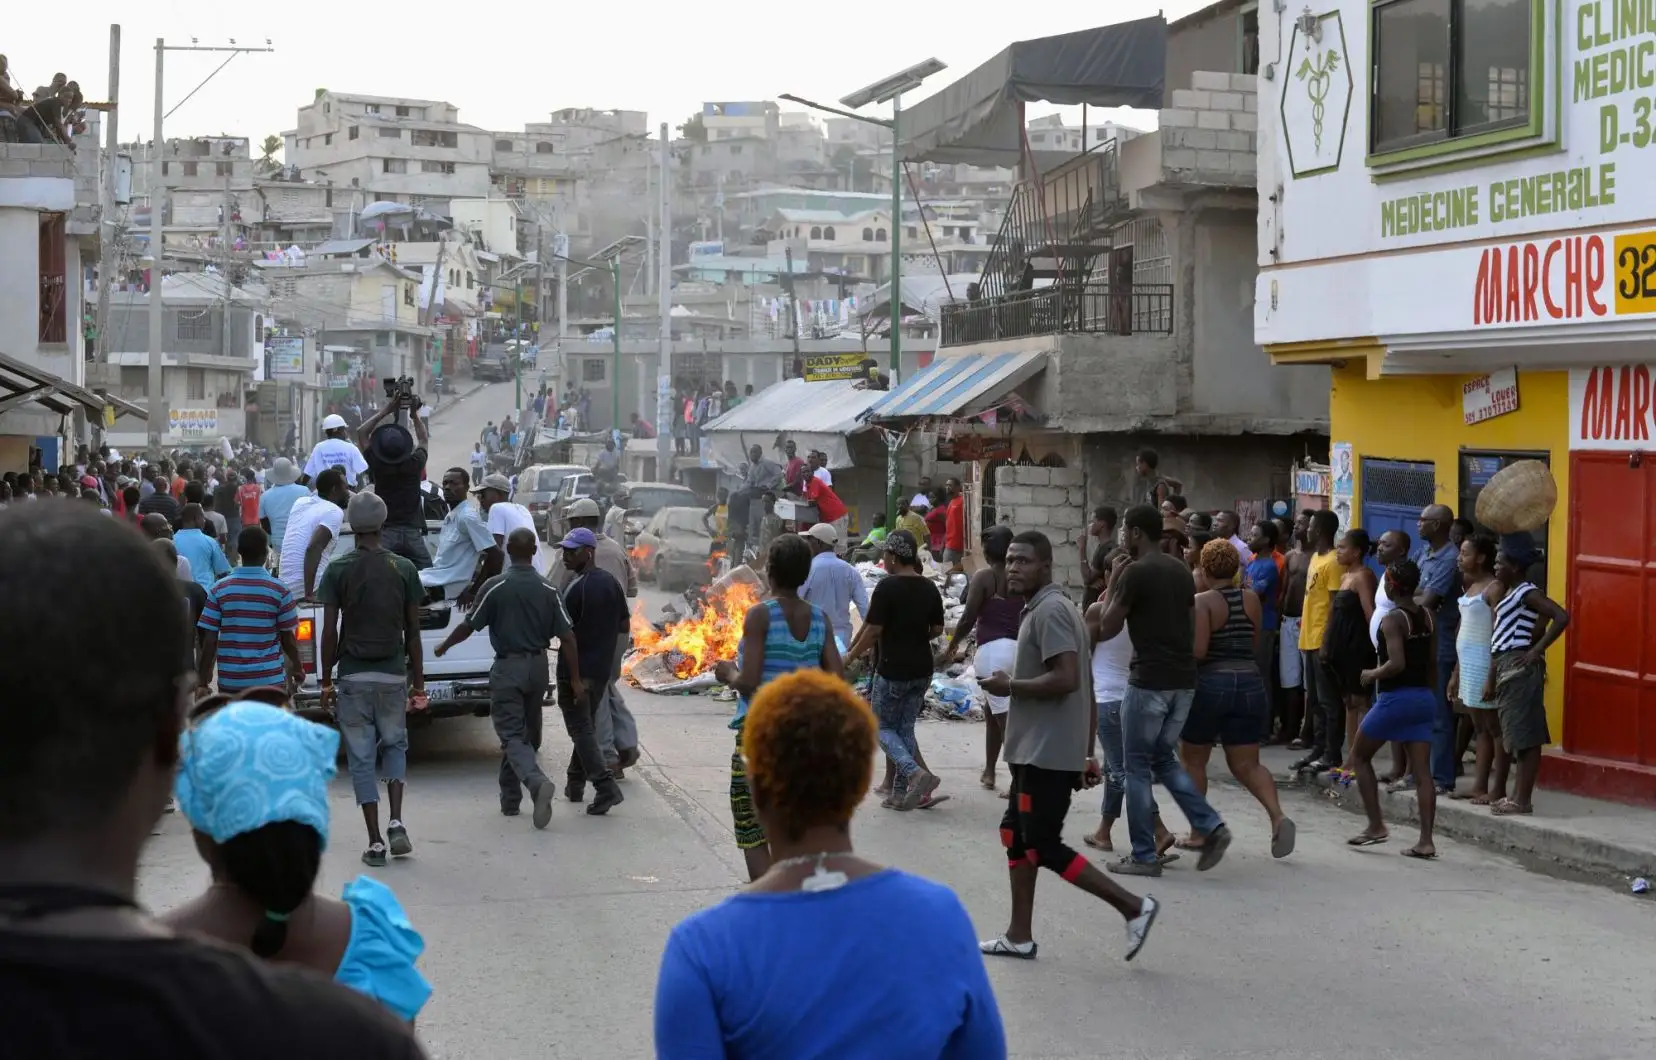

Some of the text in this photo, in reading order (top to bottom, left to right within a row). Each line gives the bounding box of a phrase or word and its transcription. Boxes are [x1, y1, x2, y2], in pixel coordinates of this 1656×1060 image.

[1600, 96, 1656, 155] D-3
[1381, 186, 1478, 237] MEDECINE
[1491, 385, 1516, 403] LOUER
[1581, 363, 1656, 440] MAR
